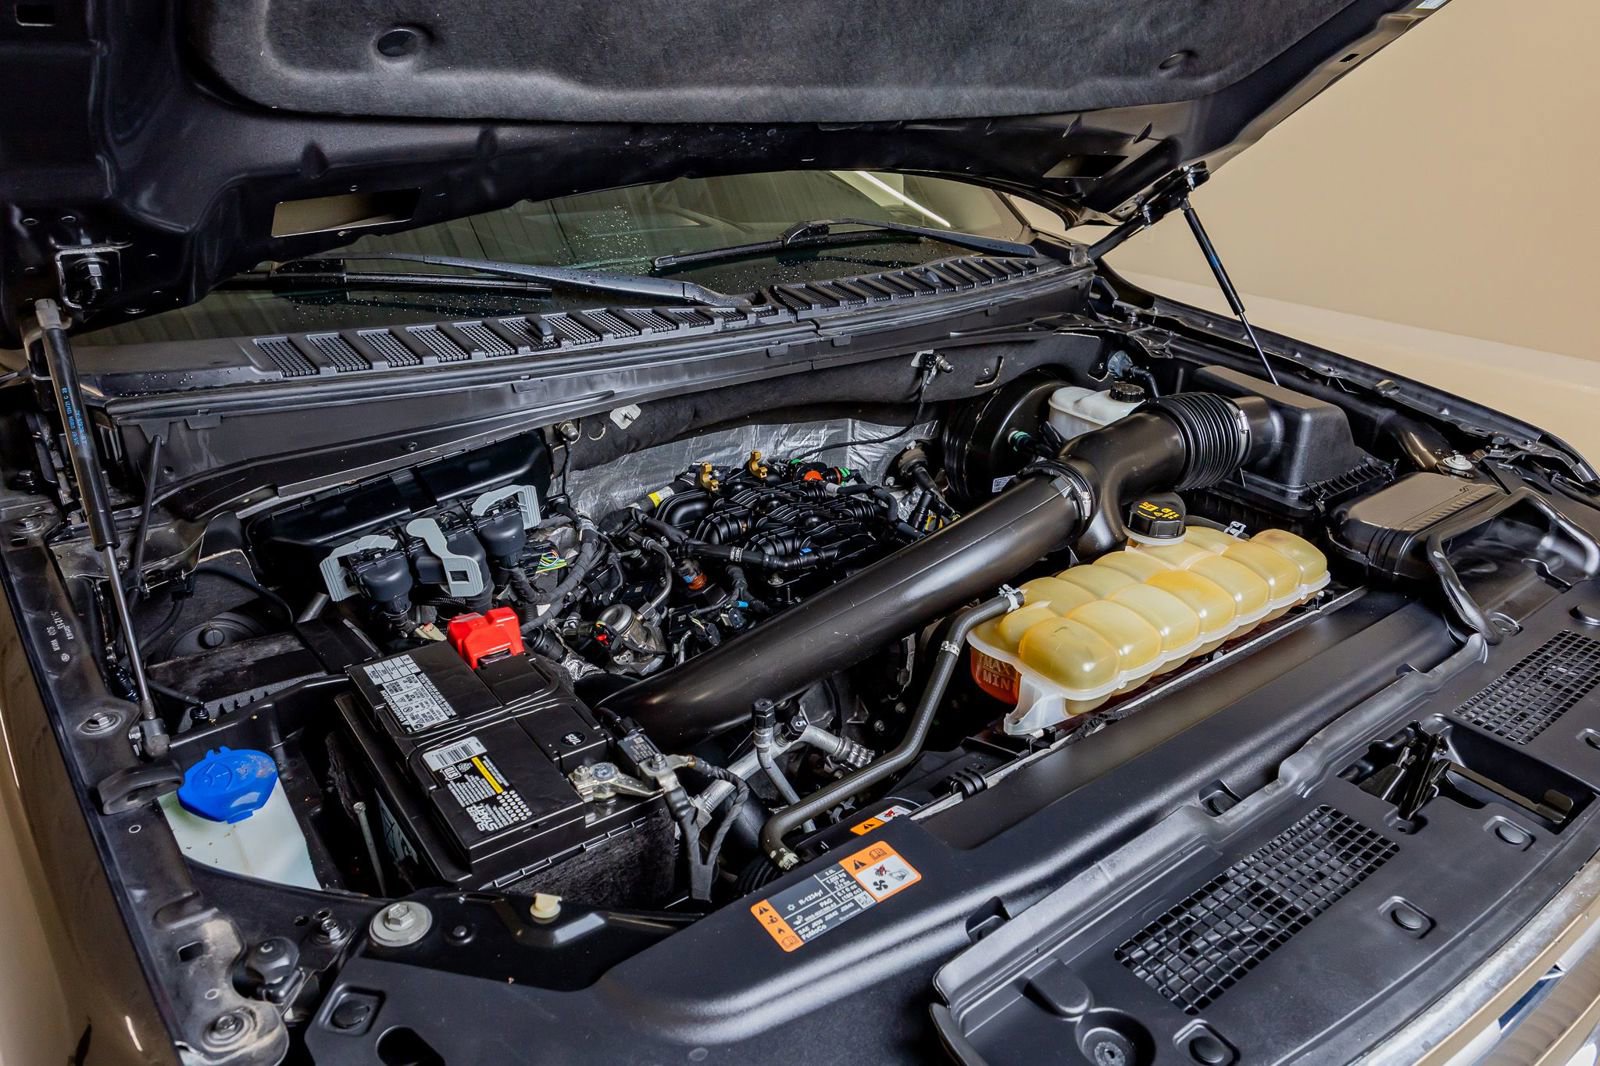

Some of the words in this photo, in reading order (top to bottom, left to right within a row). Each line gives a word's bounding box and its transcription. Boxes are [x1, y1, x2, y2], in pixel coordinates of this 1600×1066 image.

[983, 656, 1010, 676] MAX
[983, 669, 1010, 690] MIN
[466, 804, 487, 831] SUPER
[474, 802, 499, 831] START
